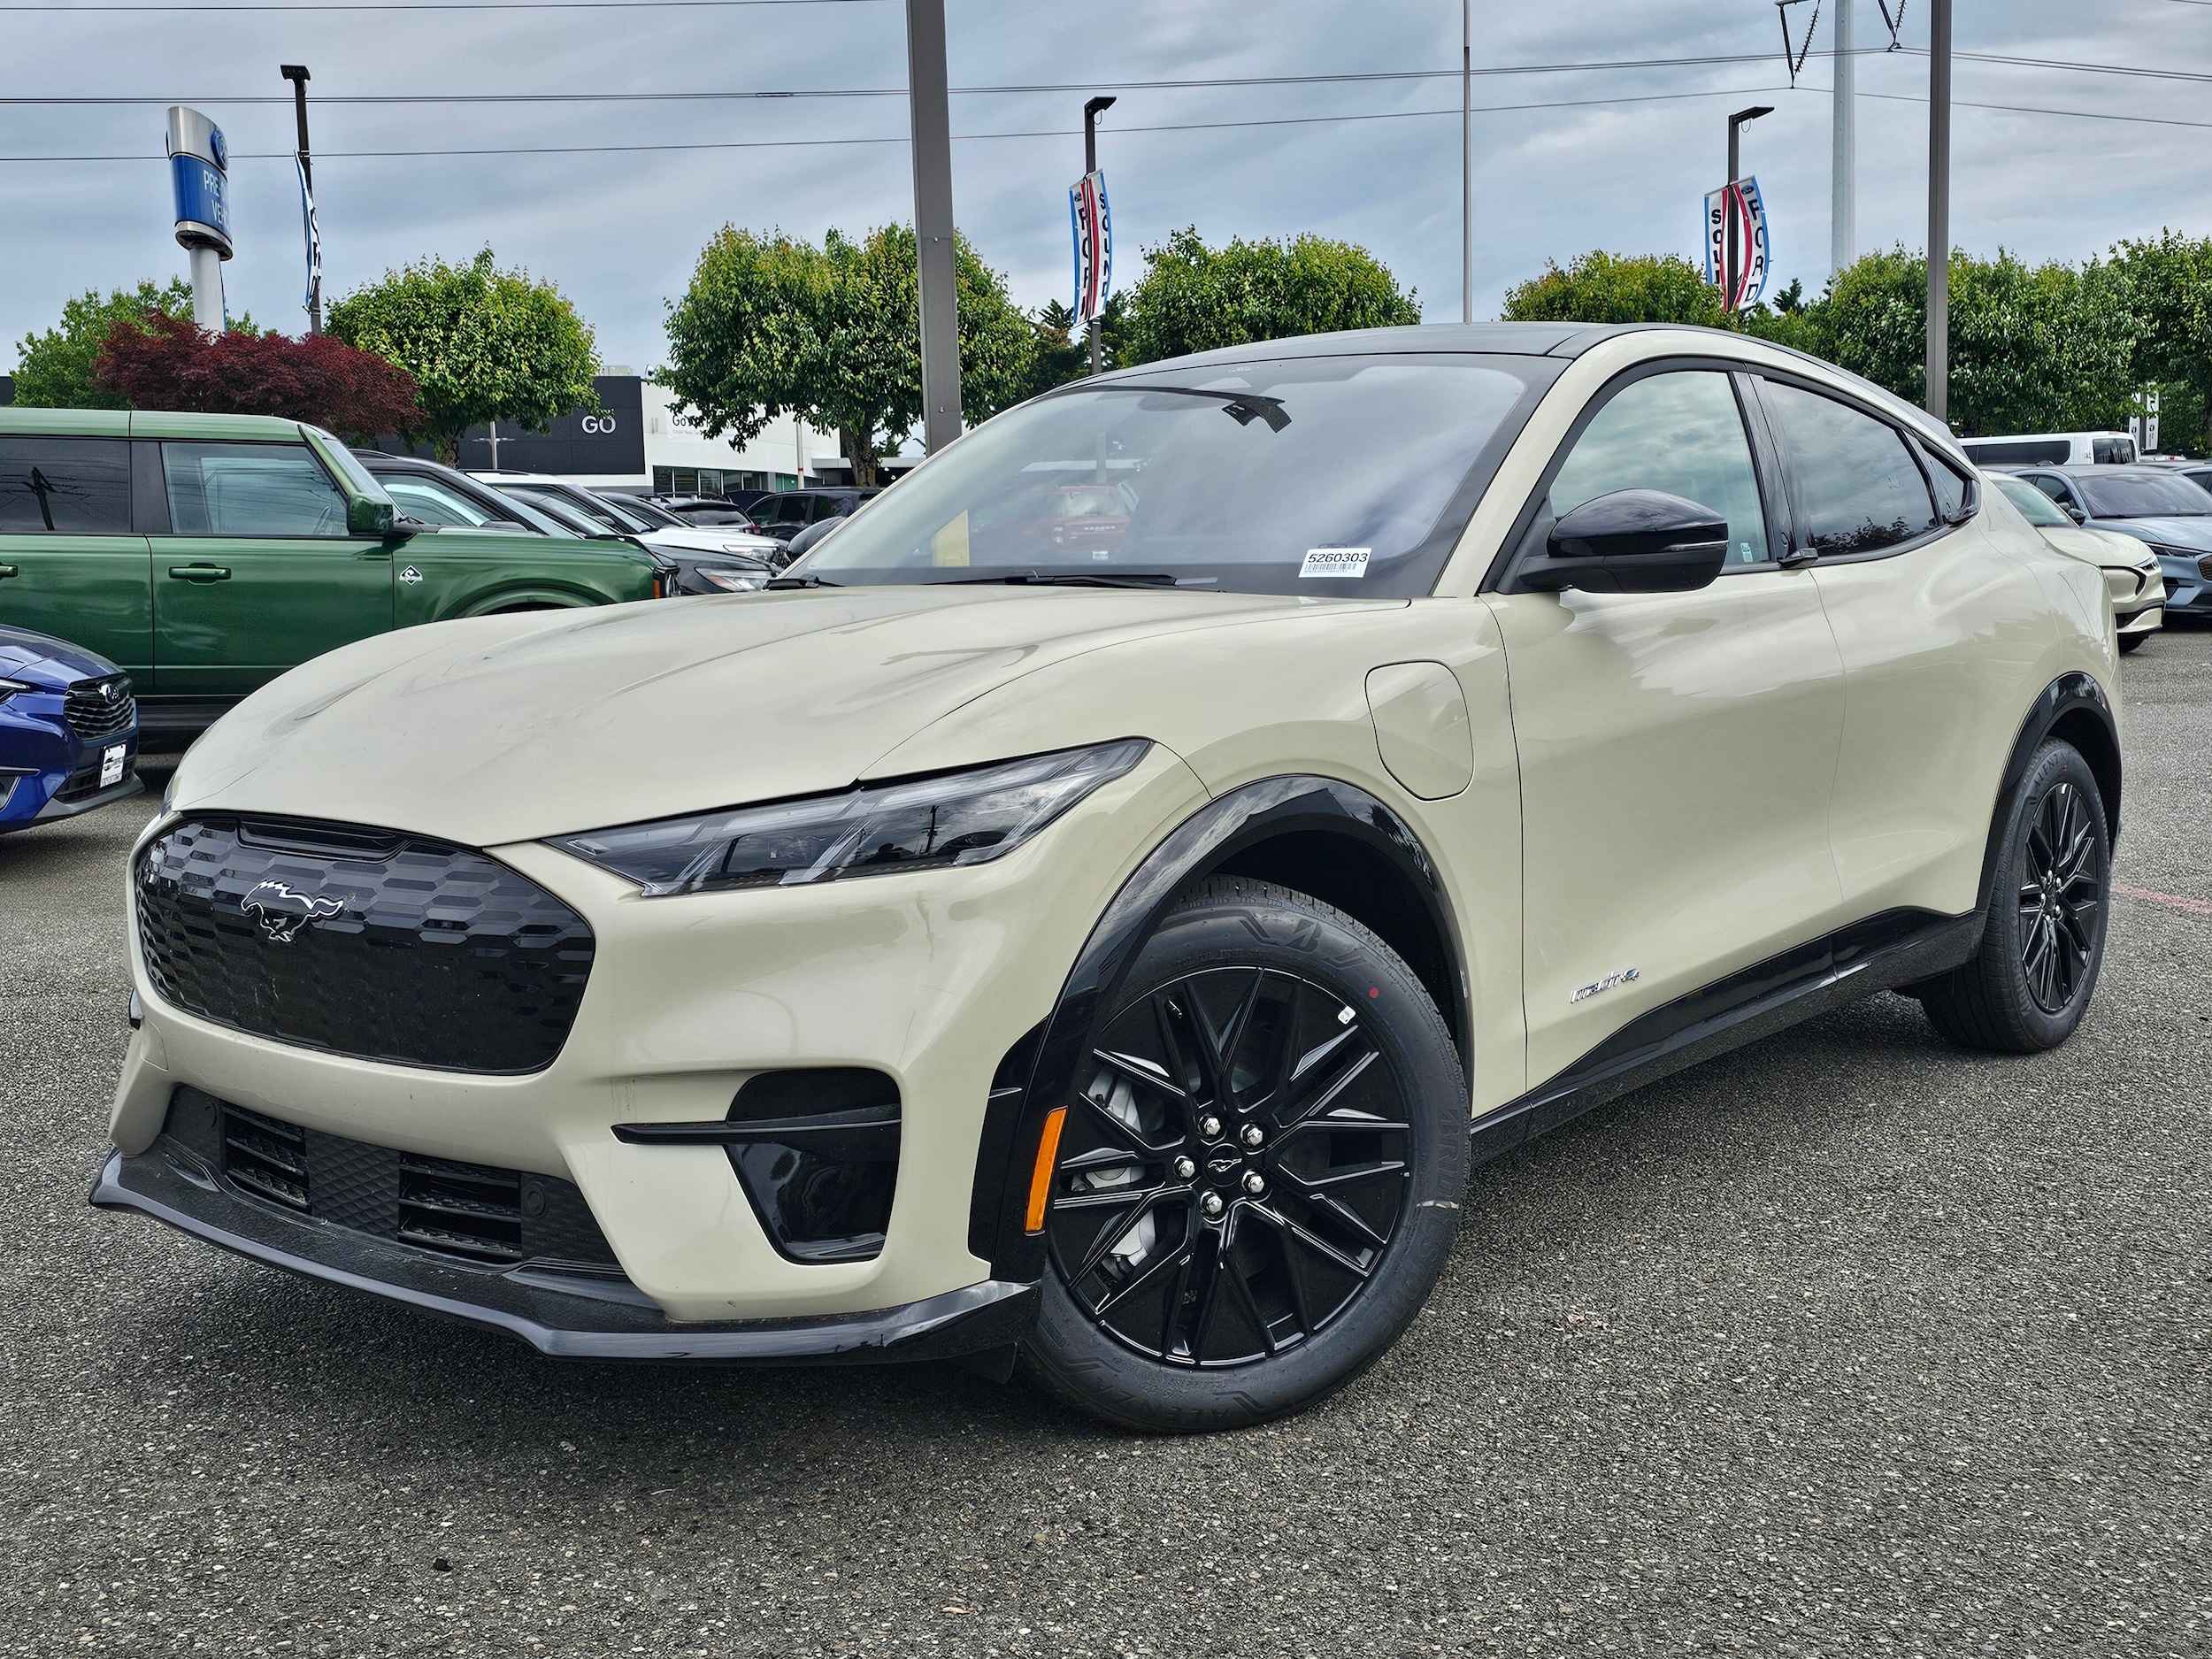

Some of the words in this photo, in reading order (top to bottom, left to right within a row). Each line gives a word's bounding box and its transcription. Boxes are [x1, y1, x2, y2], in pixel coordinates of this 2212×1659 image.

[1745, 199, 1763, 302] FORD
[582, 415, 616, 434] GO
[1308, 553, 1368, 563] 5260303
